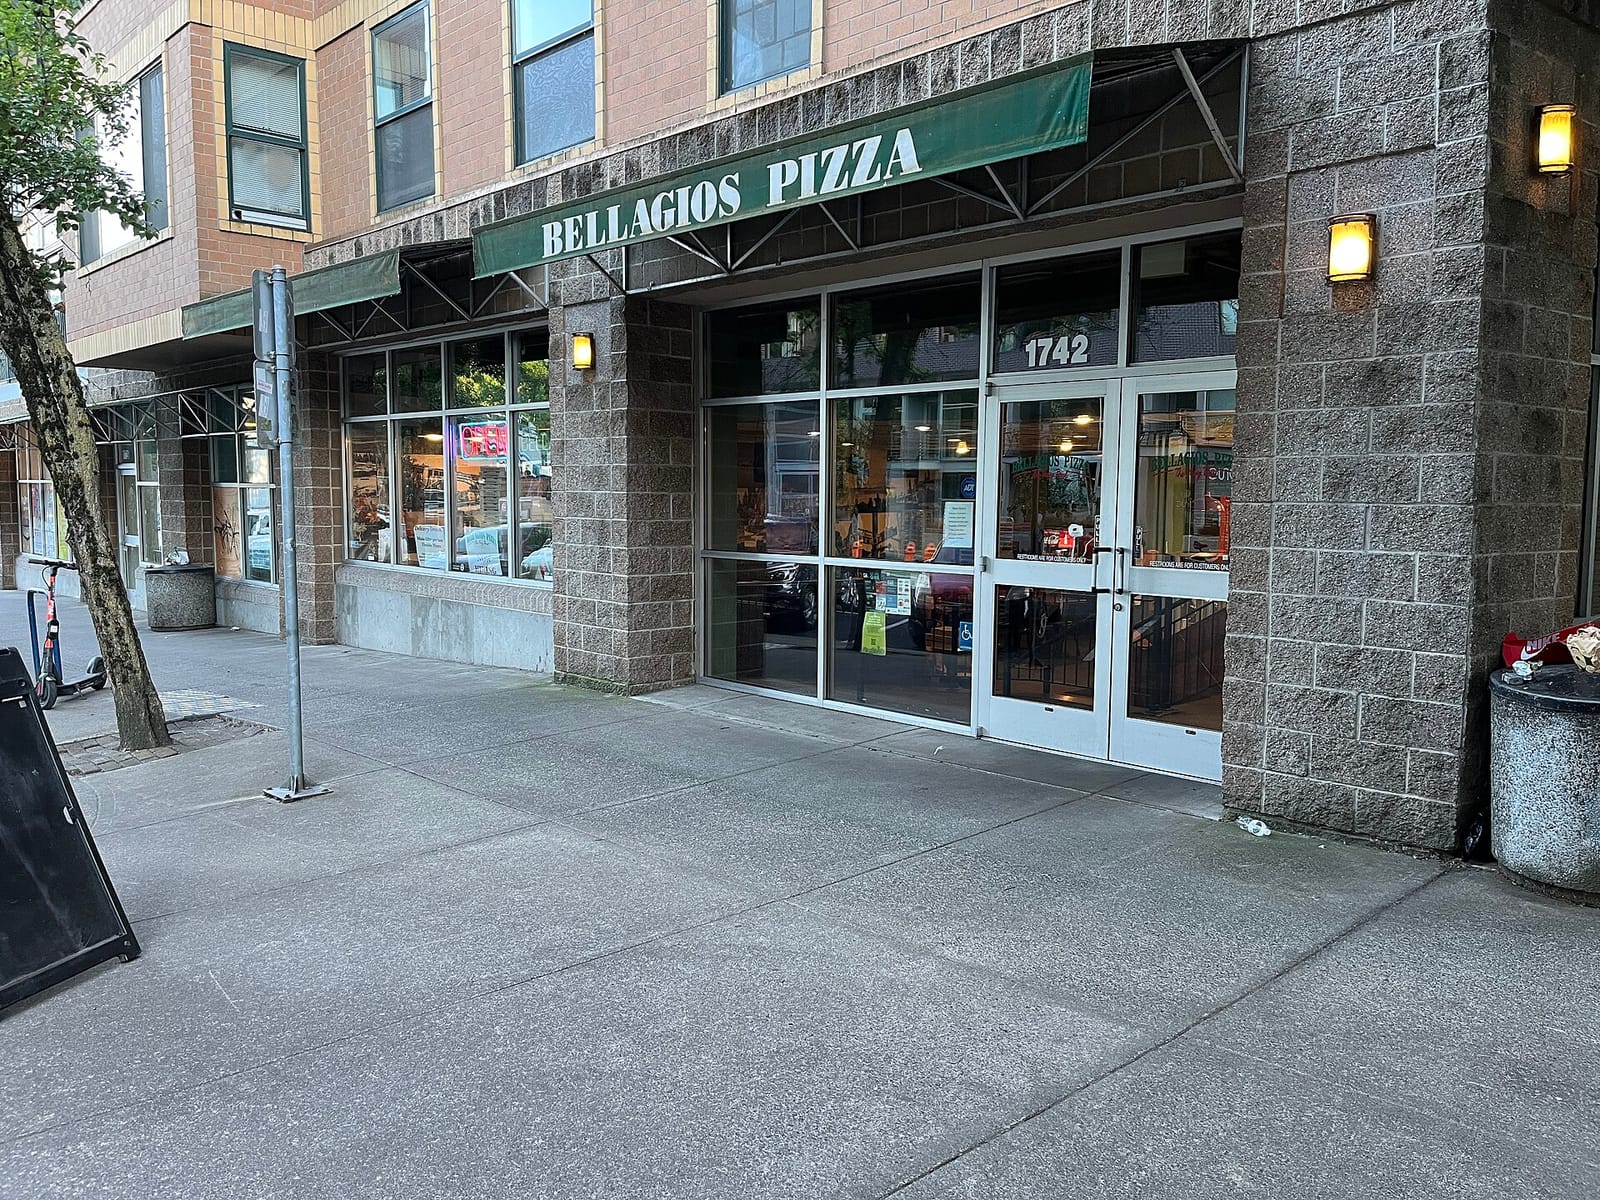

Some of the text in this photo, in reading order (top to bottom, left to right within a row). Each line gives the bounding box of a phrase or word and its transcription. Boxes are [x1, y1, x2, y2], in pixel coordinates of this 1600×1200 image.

[542, 128, 923, 259] BELLAGIOS PIZZA
[1026, 335, 1088, 367] 1742
[1151, 451, 1209, 471] BELLAGIOS
[1214, 452, 1233, 465] PIZ
[1149, 560, 1175, 568] RESTROOMS
[1194, 562, 1220, 570] CUSTOMERS
[1526, 632, 1560, 652] NIKE
